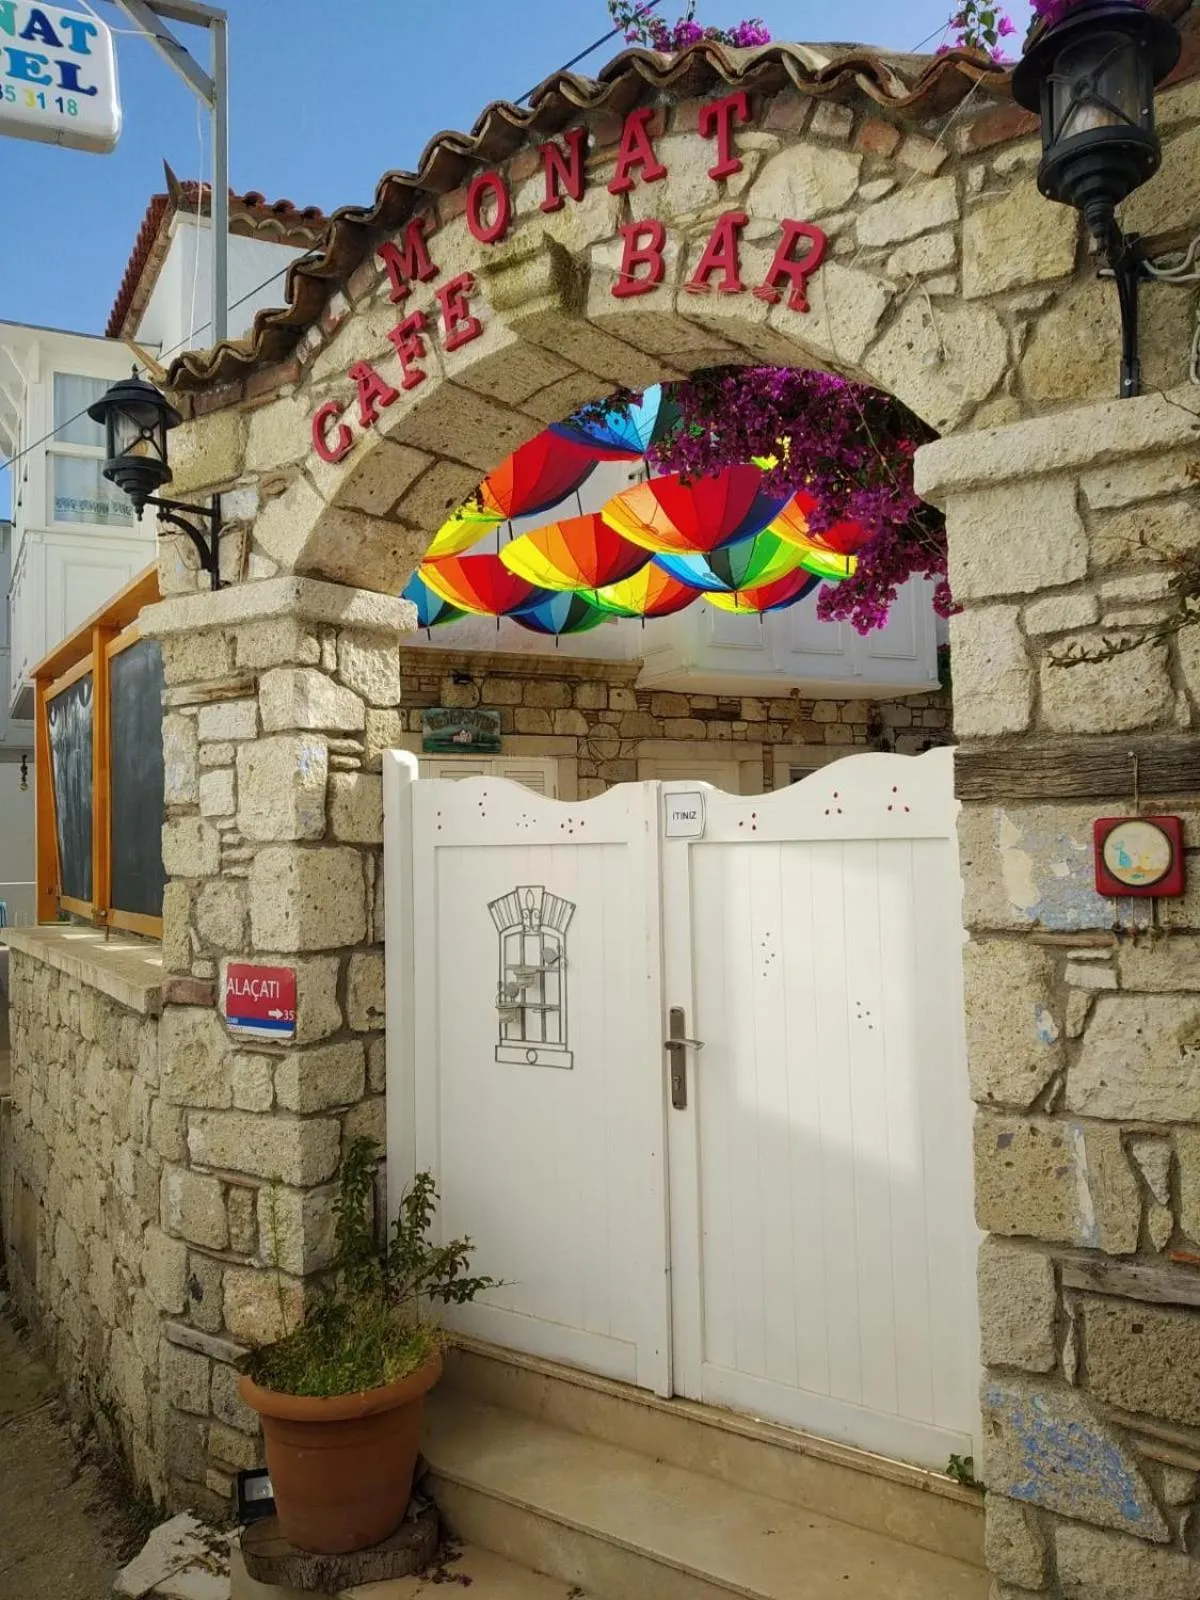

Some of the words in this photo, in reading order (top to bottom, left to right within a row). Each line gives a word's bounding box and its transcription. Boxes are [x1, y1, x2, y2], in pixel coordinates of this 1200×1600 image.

[0, 46, 98, 96] EL
[24, 87, 46, 110] 31
[55, 96, 78, 117] 18
[377, 91, 752, 303] MONAT
[311, 271, 484, 465] CAFE
[611, 211, 829, 313] BAR
[227, 977, 280, 1002] ALAÇATI
